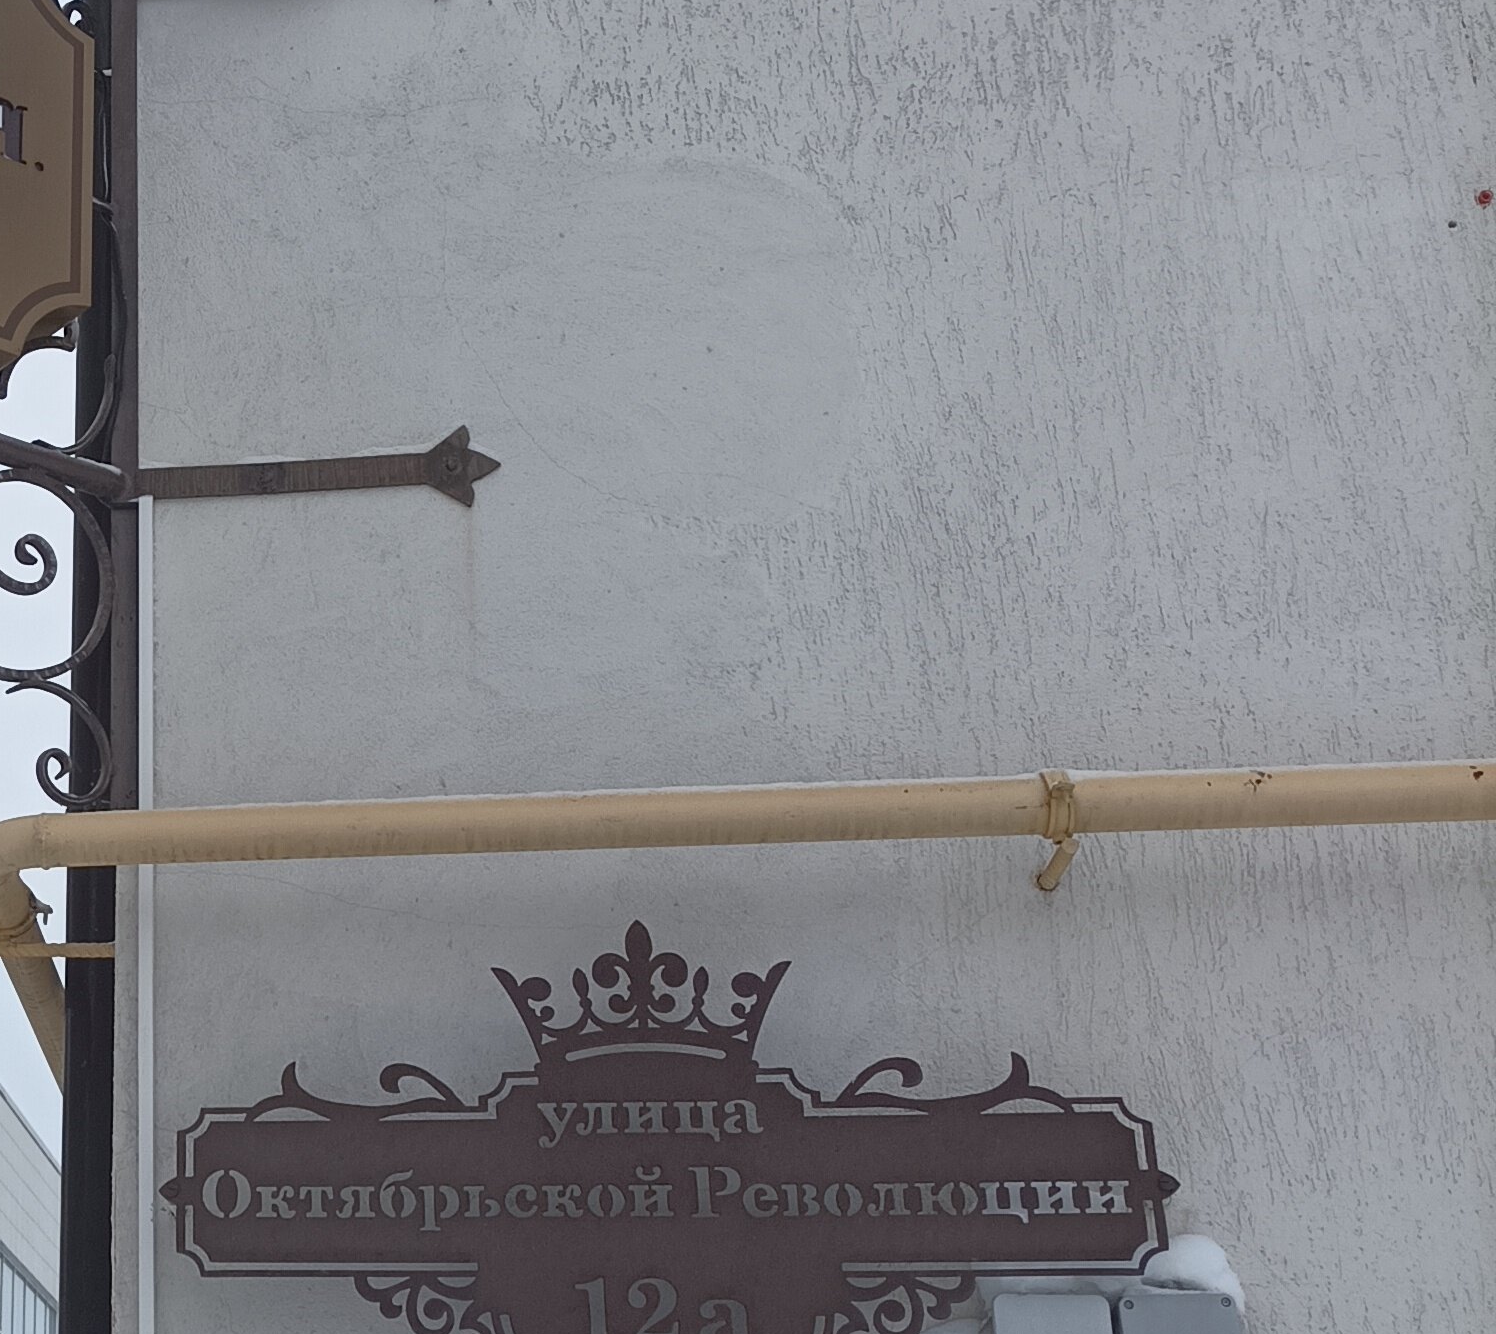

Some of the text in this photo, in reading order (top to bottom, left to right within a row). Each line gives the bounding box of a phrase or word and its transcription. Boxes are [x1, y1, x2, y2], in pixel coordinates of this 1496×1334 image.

[537, 1098, 764, 1149] улица
[201, 1165, 1133, 1232] Октябрьской Революции
